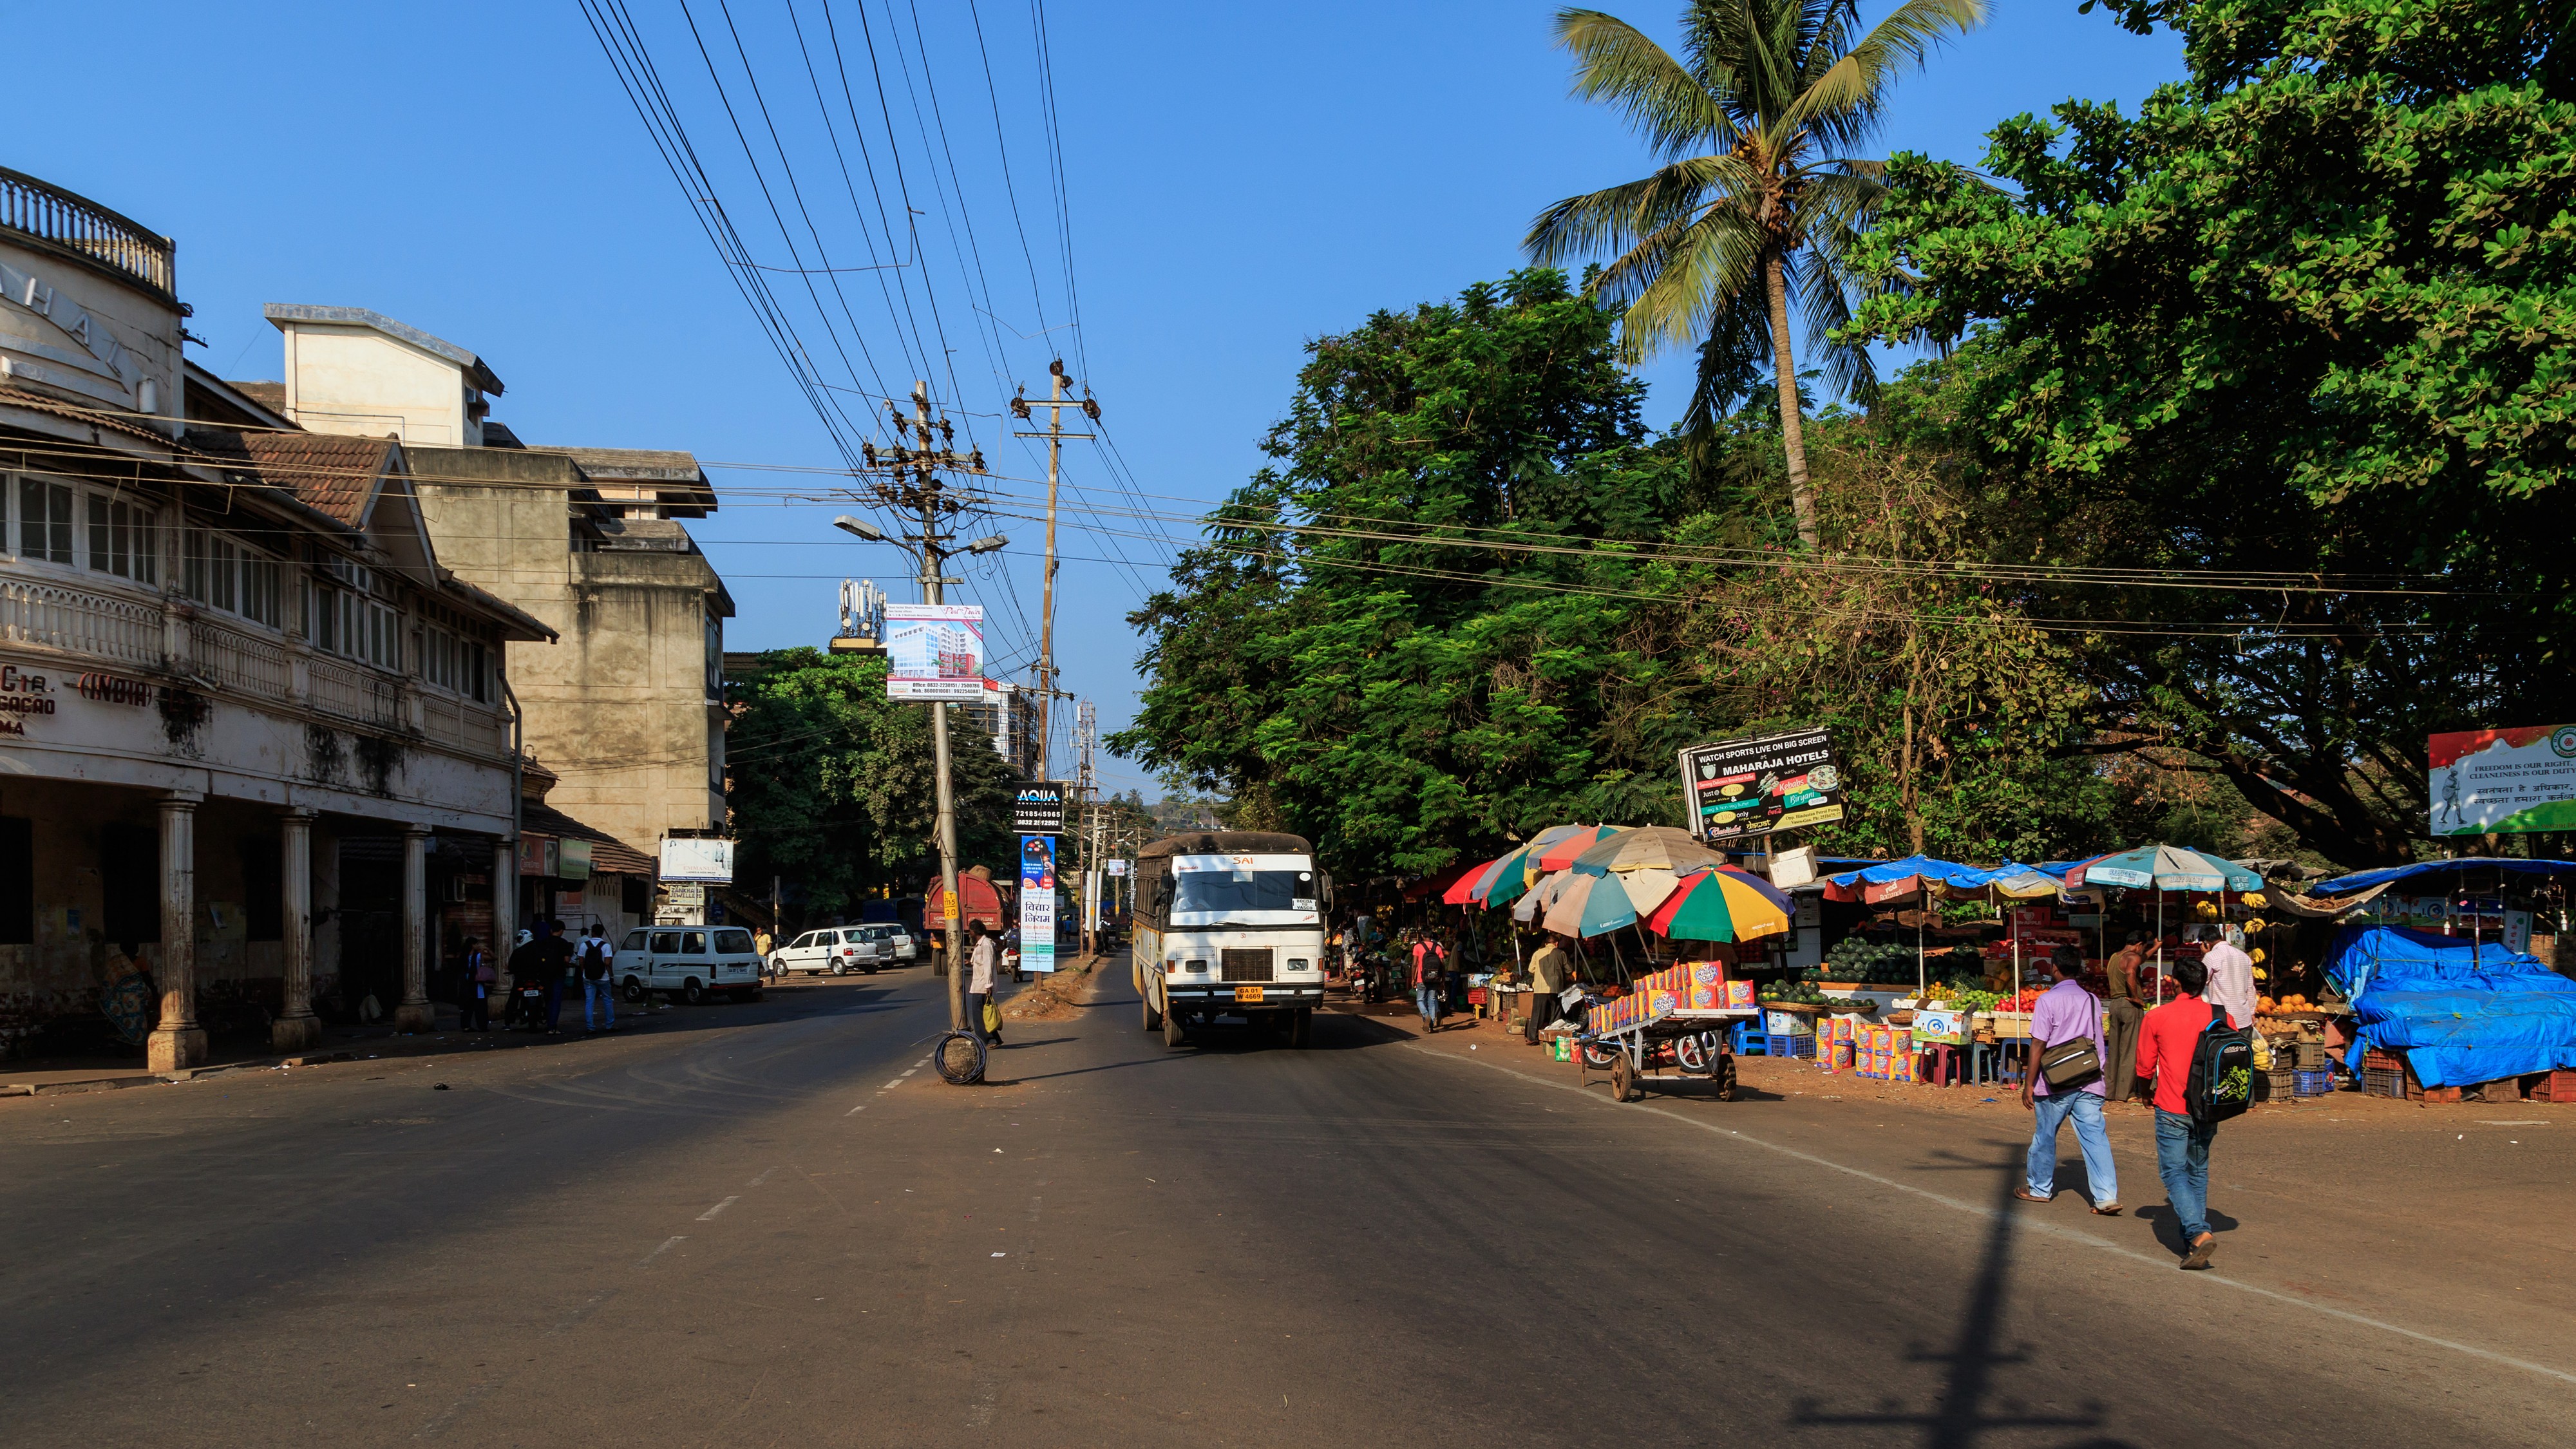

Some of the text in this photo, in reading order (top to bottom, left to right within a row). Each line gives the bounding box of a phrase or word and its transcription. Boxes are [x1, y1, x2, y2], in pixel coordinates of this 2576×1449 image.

[1699, 734, 1827, 763] WATCH SPORTS LIVE ON BIG SCREEN
[1723, 758, 1784, 776] MAHARAJA
[1786, 749, 1829, 765] HOTELS
[1779, 779, 1804, 791] Kebabs
[1018, 790, 1059, 802] AQUA
[1790, 790, 1815, 805] Biryani
[1025, 901, 1050, 911] विचार
[1025, 912, 1050, 923] नियम
[1698, 969, 1715, 978] Knock
